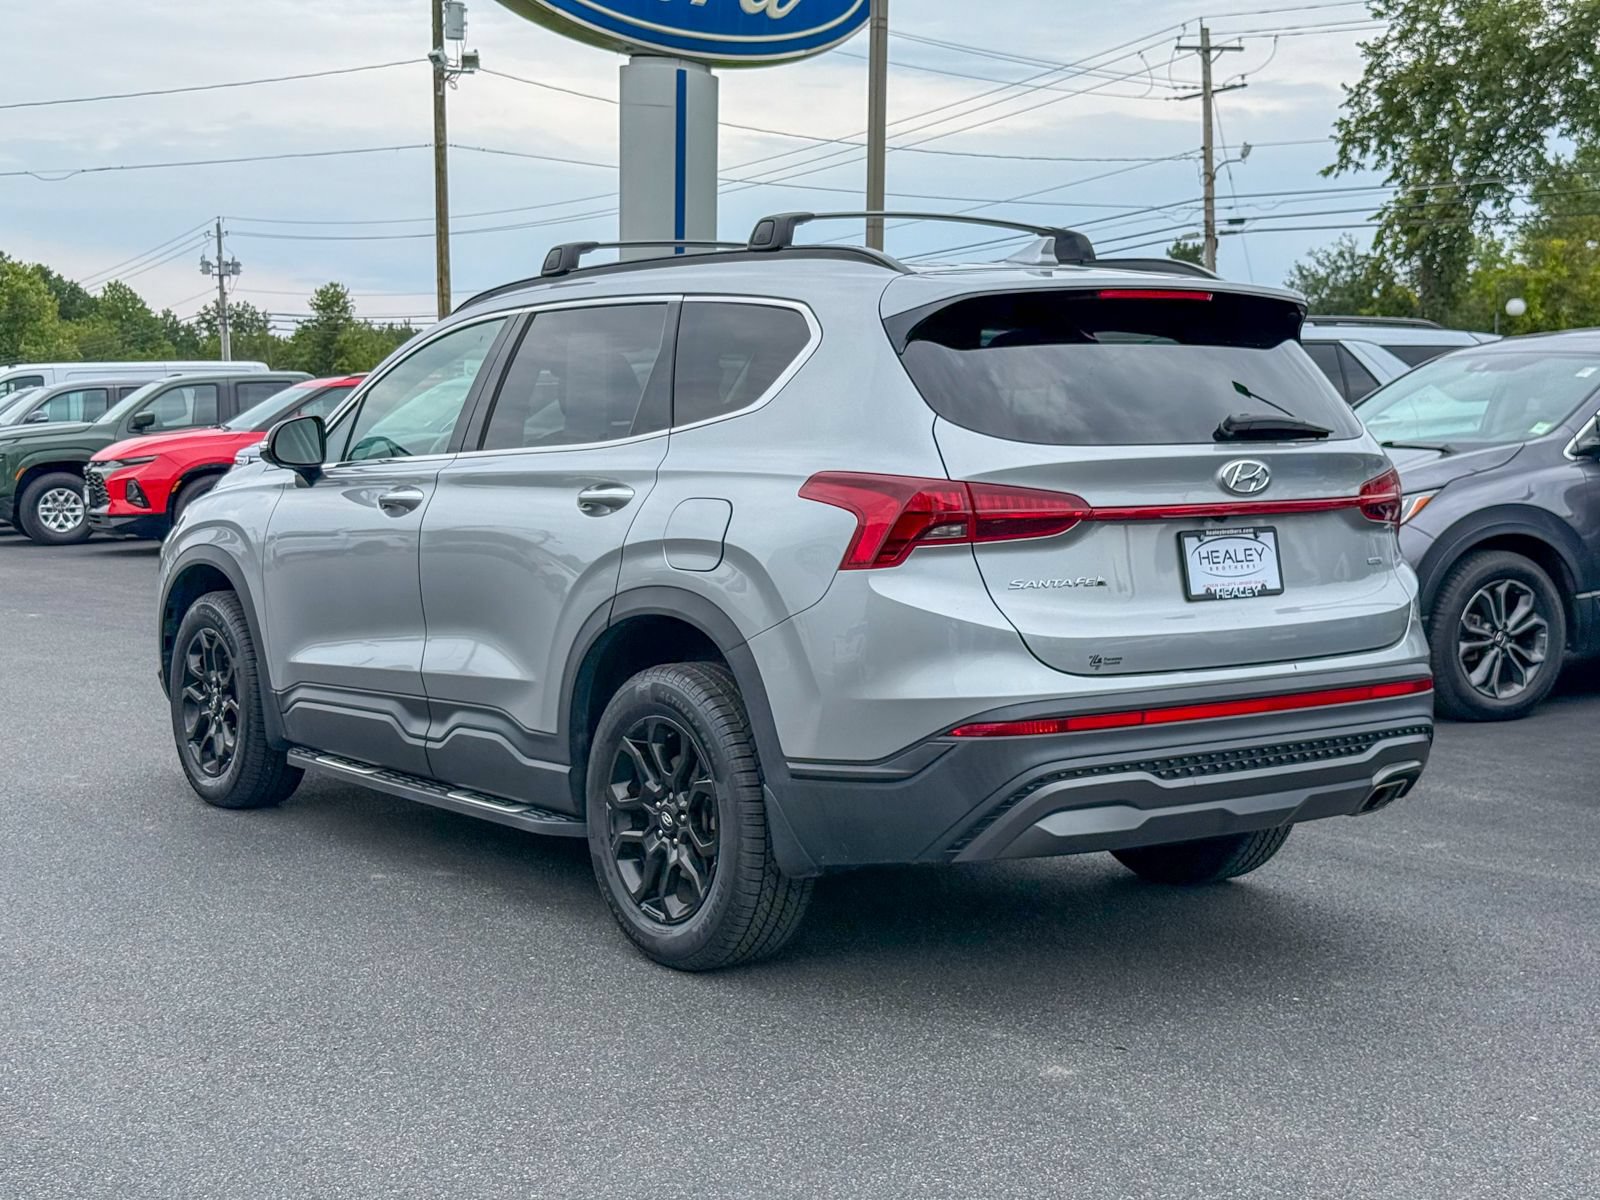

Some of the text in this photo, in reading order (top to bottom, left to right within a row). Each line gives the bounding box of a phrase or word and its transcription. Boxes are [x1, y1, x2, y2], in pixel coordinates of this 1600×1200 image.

[1198, 547, 1265, 566] HEALEY
[1209, 563, 1257, 572] BROTHERS
[1215, 585, 1259, 600] HEALEY
